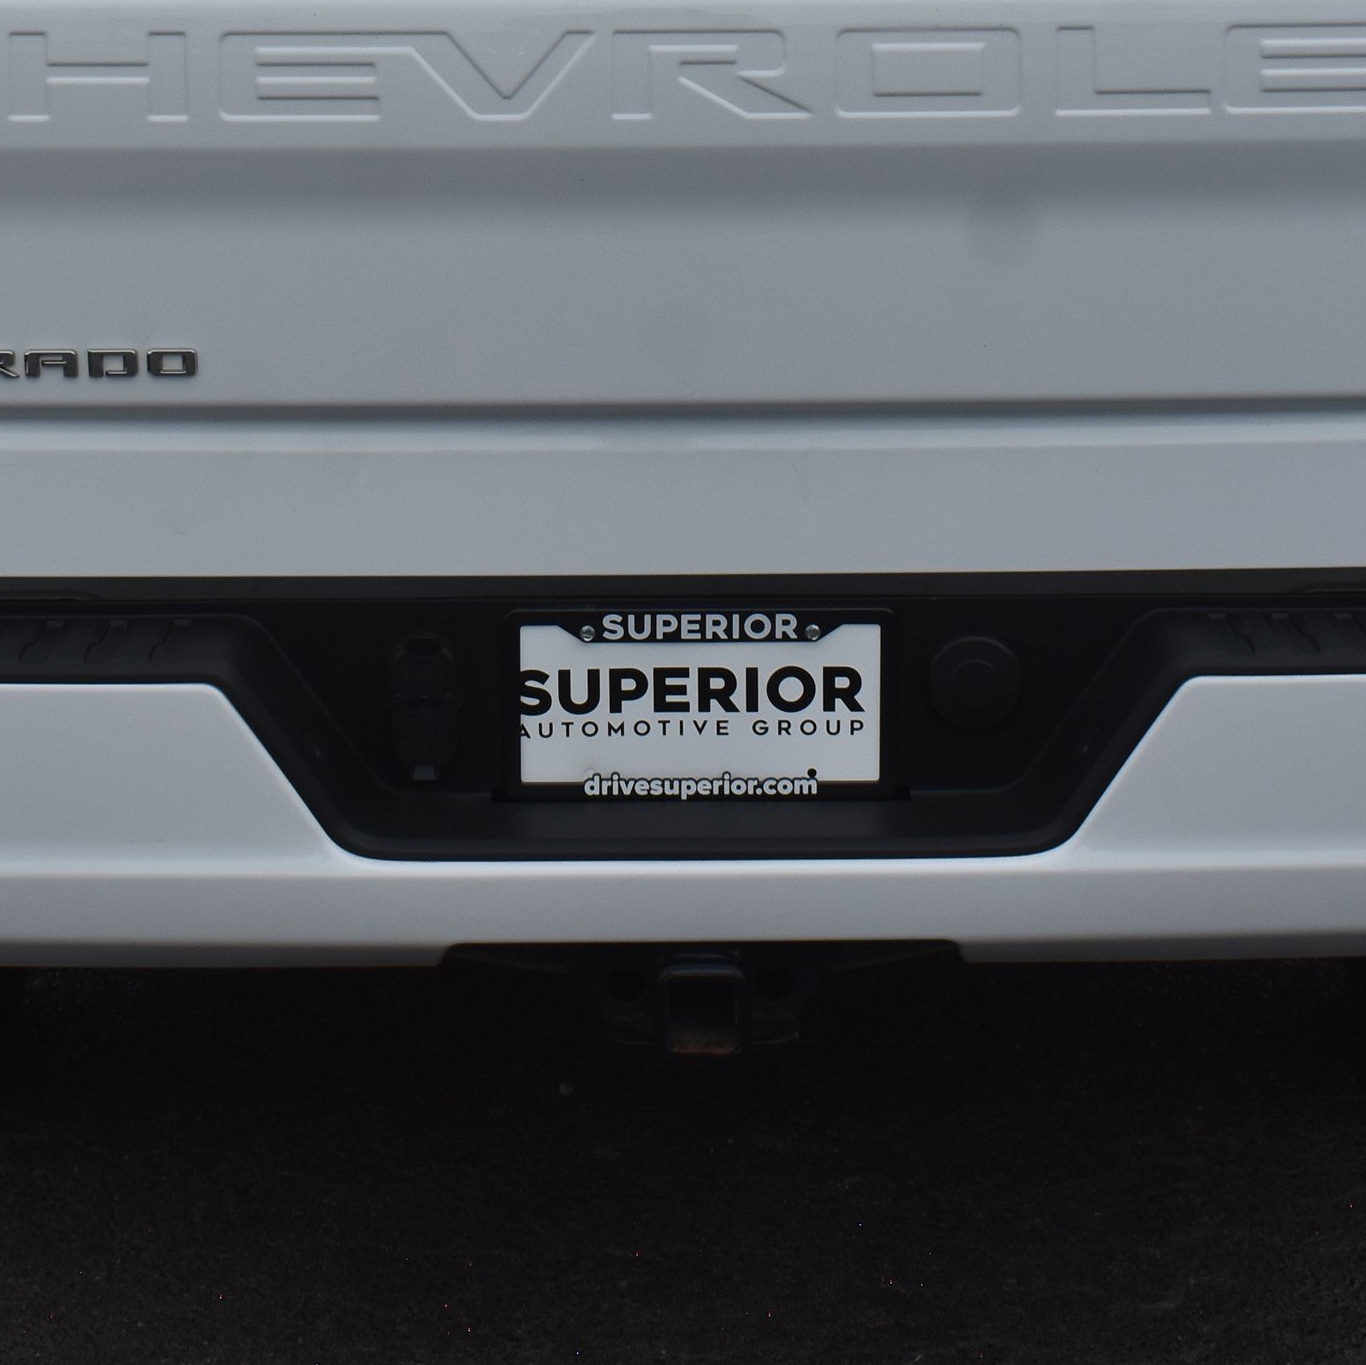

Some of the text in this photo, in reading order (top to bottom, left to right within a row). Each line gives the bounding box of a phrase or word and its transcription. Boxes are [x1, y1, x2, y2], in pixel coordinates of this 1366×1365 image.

[602, 613, 799, 640] SUPERIOR
[519, 665, 866, 716] SUPERIOR
[520, 719, 865, 739] AUTOMOTIVE GROUP
[583, 773, 818, 799] drivesuperior.com
